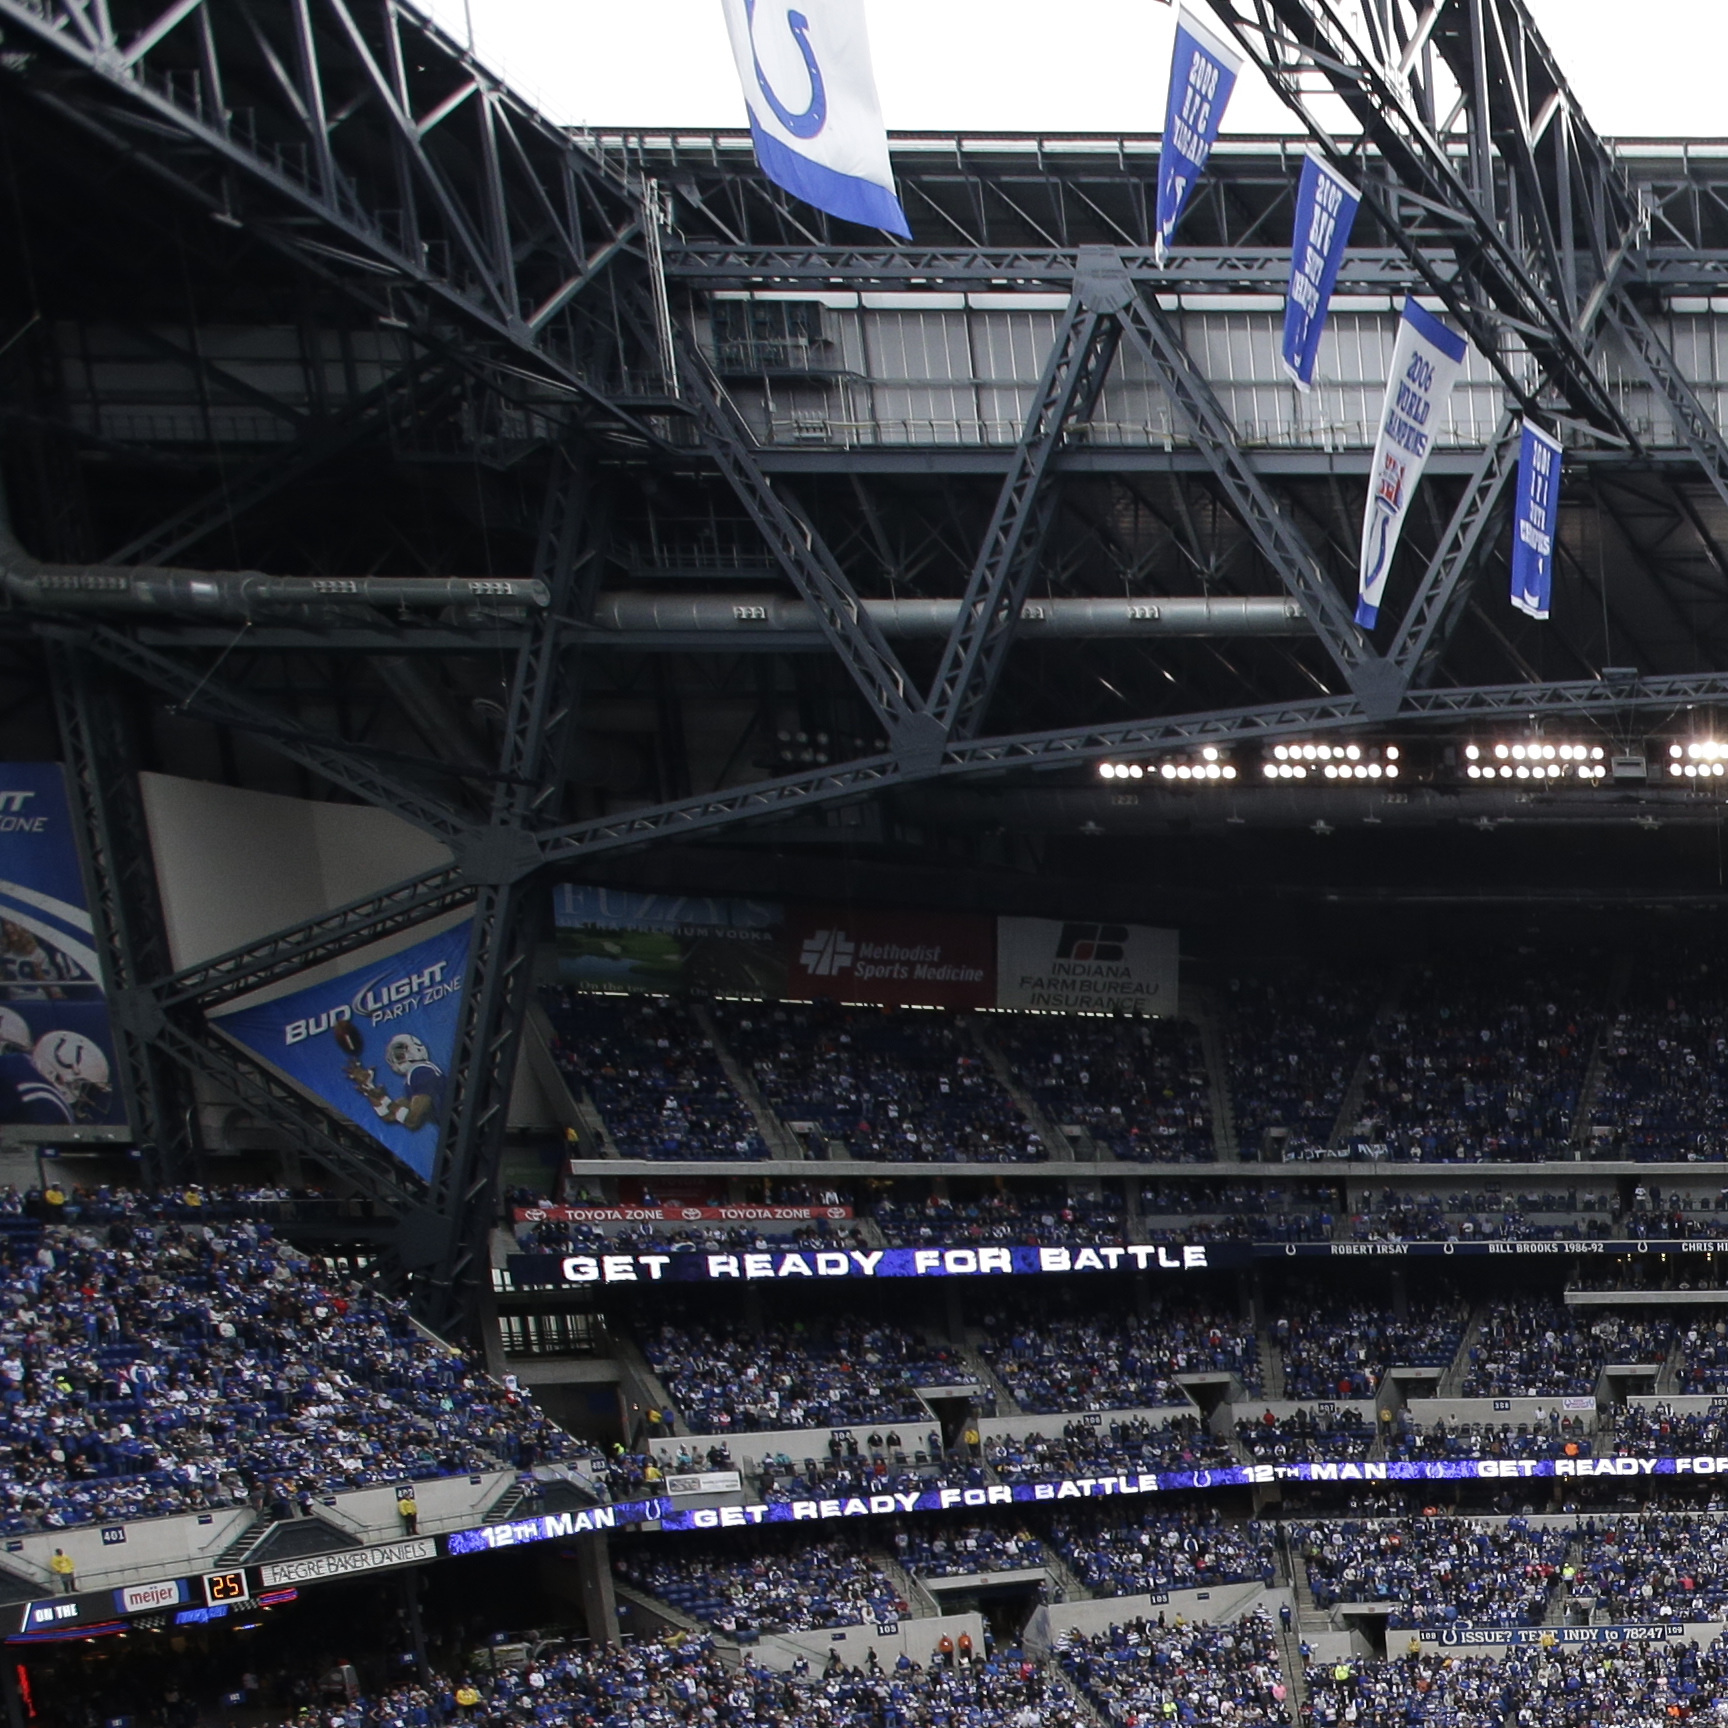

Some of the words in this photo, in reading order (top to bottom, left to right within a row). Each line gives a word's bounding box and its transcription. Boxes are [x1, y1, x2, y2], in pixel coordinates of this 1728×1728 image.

[1407, 350, 1435, 393] 2006
[859, 941, 941, 963] Methodist
[854, 961, 910, 981] Sports
[914, 965, 984, 983] Medicine
[1051, 962, 1132, 979] INDIANA
[285, 1004, 352, 1045] BUD
[366, 960, 447, 1011] LIGHT
[371, 996, 421, 1027] PARTY
[423, 976, 462, 1005] ZONE
[1031, 992, 1147, 1009] INSURANCE
[564, 1210, 623, 1222] TOYOTA
[626, 1208, 664, 1220] ZONE
[719, 1208, 773, 1220] TOYOTA
[775, 1208, 811, 1219] ZONE
[1331, 1244, 1374, 1255] ROBERT
[1377, 1244, 1408, 1255] IRSAY
[1489, 1243, 1513, 1254] BILL
[1516, 1243, 1557, 1254] BROOKS
[1682, 1242, 1713, 1252] CHRIS
[564, 1256, 669, 1282] GET
[708, 1251, 883, 1280] READY
[915, 1247, 1011, 1273] FOR
[1040, 1245, 1207, 1271] BATTLE
[1242, 1464, 1299, 1482] 12TH
[1308, 1463, 1386, 1479] MAN
[1475, 1460, 1537, 1477] GET
[1555, 1458, 1657, 1476] READY
[693, 1505, 768, 1527] GET
[793, 1492, 920, 1519] READY
[941, 1485, 1012, 1508] FOR
[1035, 1473, 1158, 1499] BATTLE
[482, 1526, 537, 1549] 12TH
[546, 1507, 615, 1538] MAN
[271, 1558, 327, 1584] FAEGRE
[327, 1551, 370, 1573] BAKER
[370, 1541, 427, 1567] DANIELS
[130, 1586, 174, 1606] meijer
[212, 1575, 240, 1598] 25
[1152, 1595, 1167, 1604] 105
[879, 1624, 897, 1634] 105
[1461, 1631, 1513, 1643] ISSUE?
[1564, 1629, 1599, 1641] INDY
[1623, 1627, 1664, 1639] 78247
